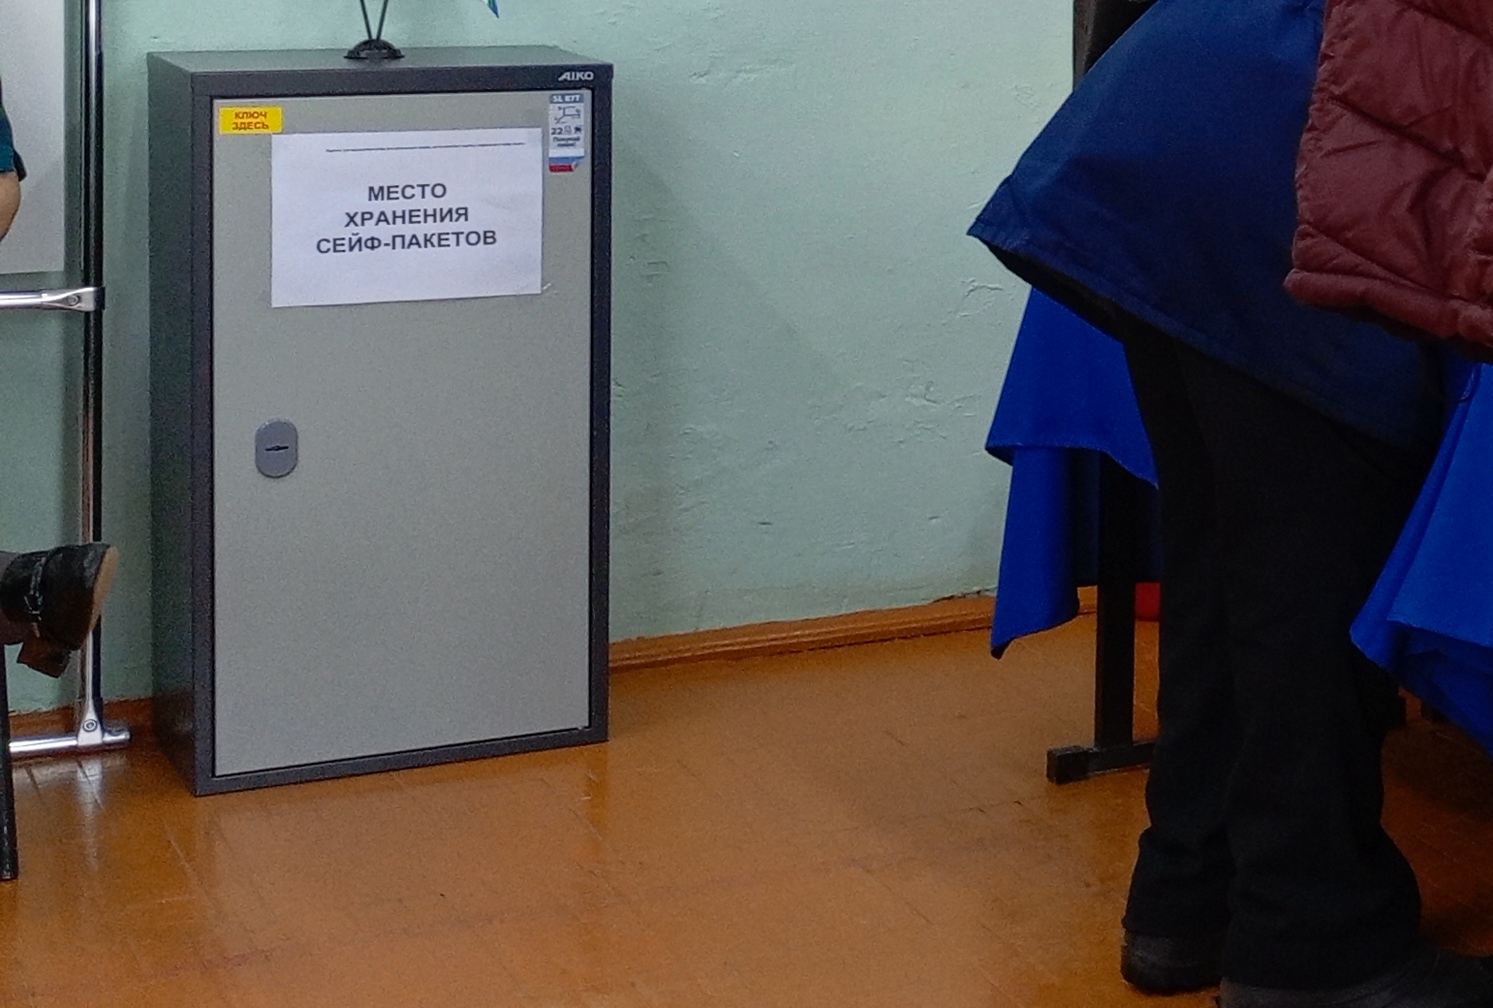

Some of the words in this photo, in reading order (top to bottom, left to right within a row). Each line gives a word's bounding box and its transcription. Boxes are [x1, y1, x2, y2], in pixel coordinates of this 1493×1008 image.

[558, 72, 594, 81] AIKO
[234, 111, 267, 120] КЛЮЧ
[232, 122, 269, 131] ЗДЕСЬ
[367, 182, 447, 202] МЕСТО
[344, 206, 469, 228] ХРАНЕНИЯ
[316, 230, 497, 254] СЕЙФ-ПАКЕТОВ
